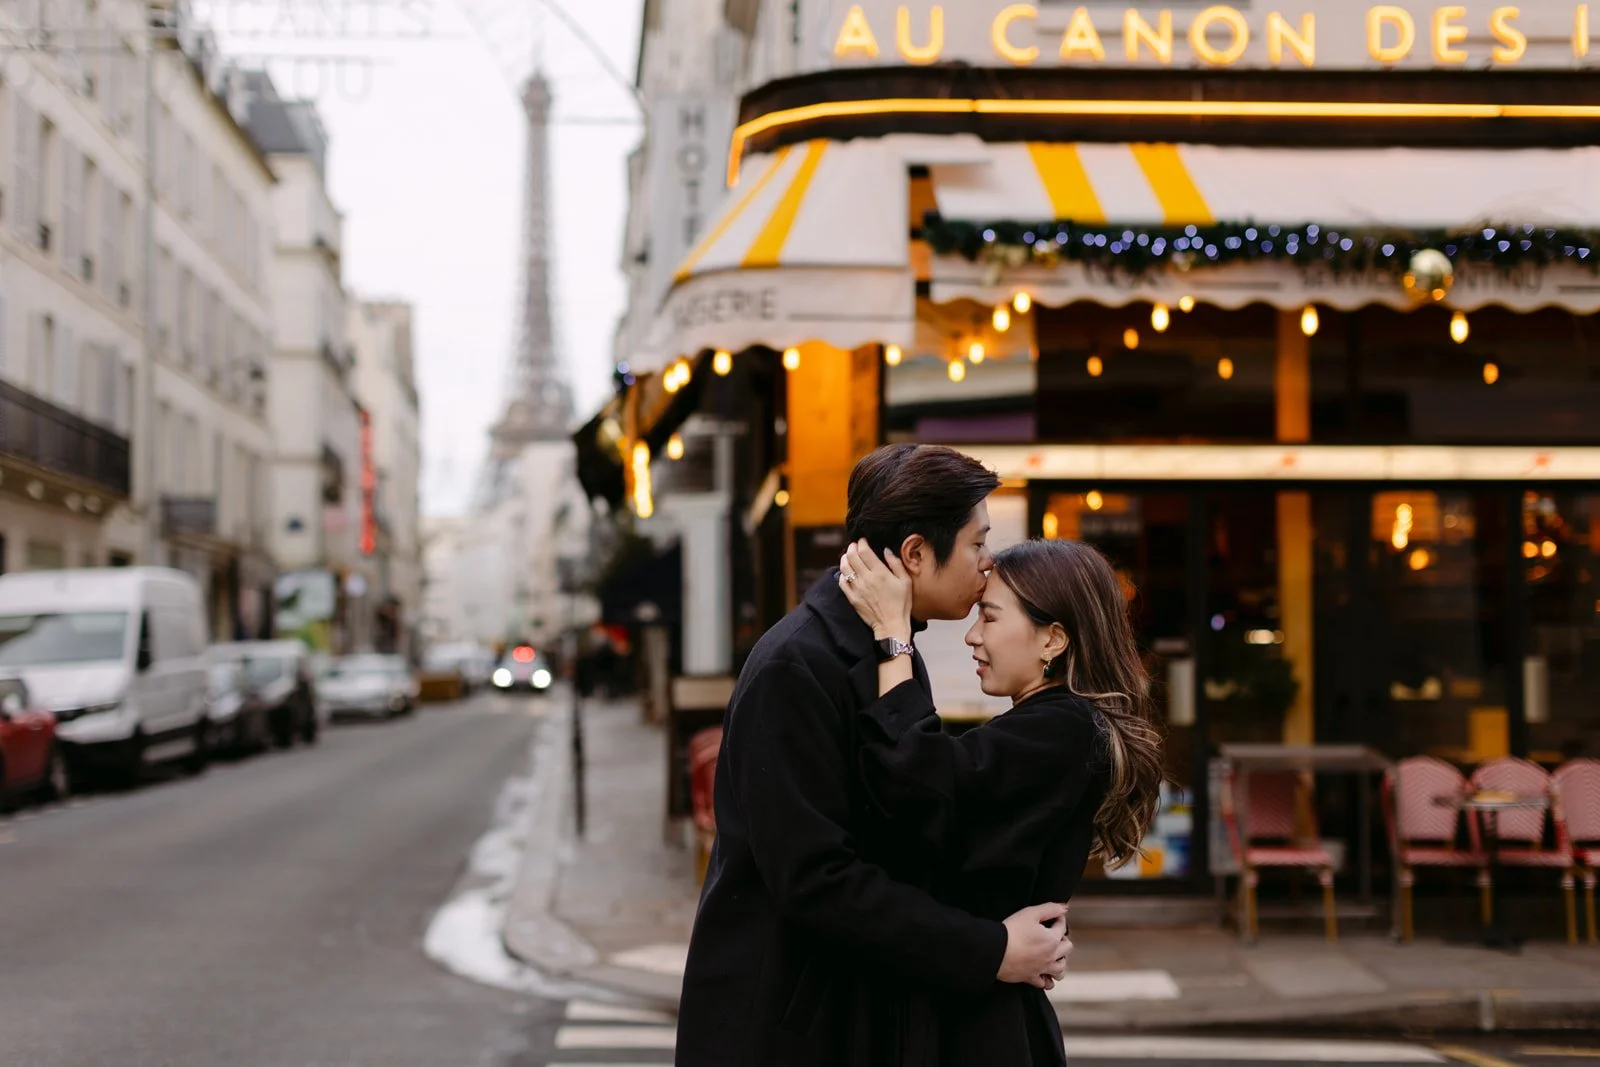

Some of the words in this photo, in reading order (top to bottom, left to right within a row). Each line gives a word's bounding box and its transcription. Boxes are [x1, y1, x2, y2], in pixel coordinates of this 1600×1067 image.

[835, 5, 943, 65] AU
[991, 4, 1315, 67] CANON
[1367, 5, 1527, 63] DES
